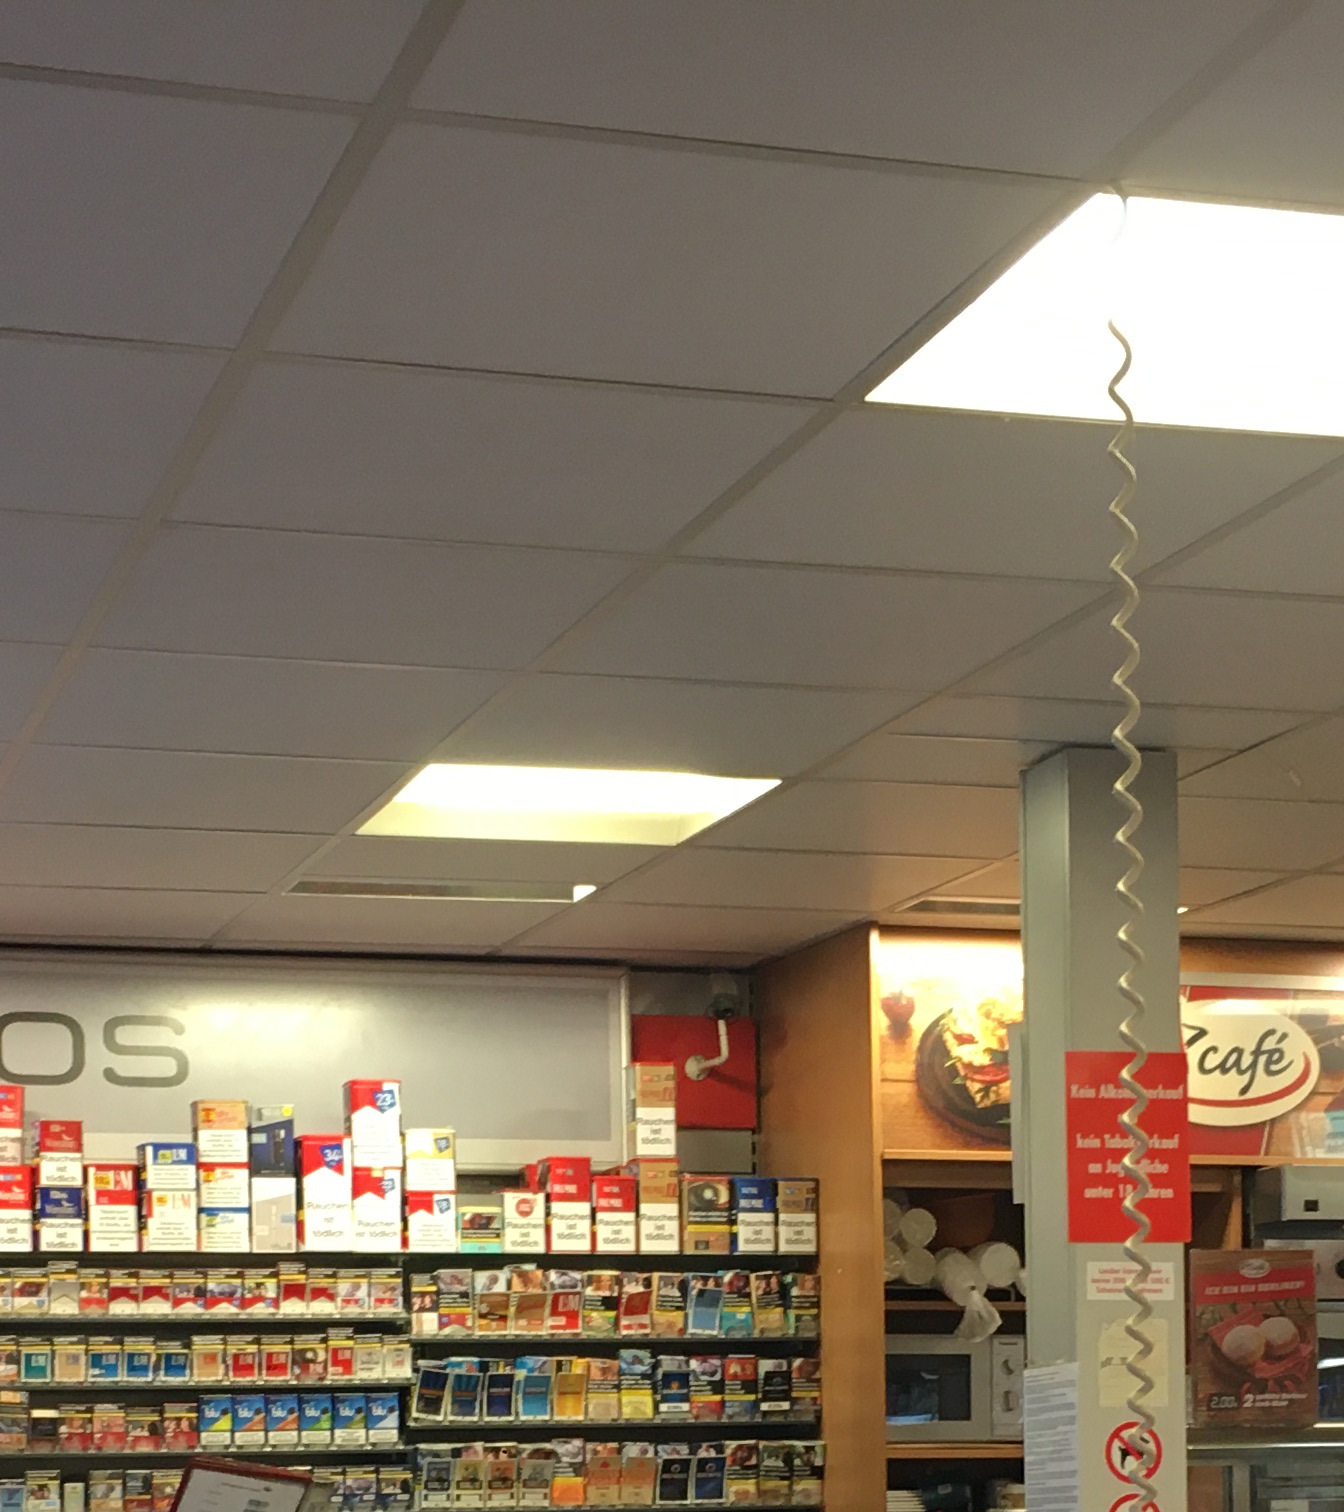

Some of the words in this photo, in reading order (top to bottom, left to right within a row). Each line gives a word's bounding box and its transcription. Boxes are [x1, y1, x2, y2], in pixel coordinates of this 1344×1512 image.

[1198, 1027, 1294, 1096] café
[1071, 1084, 1096, 1099] Kein
[1076, 1133, 1101, 1149] kein
[1084, 1186, 1114, 1199] unter
